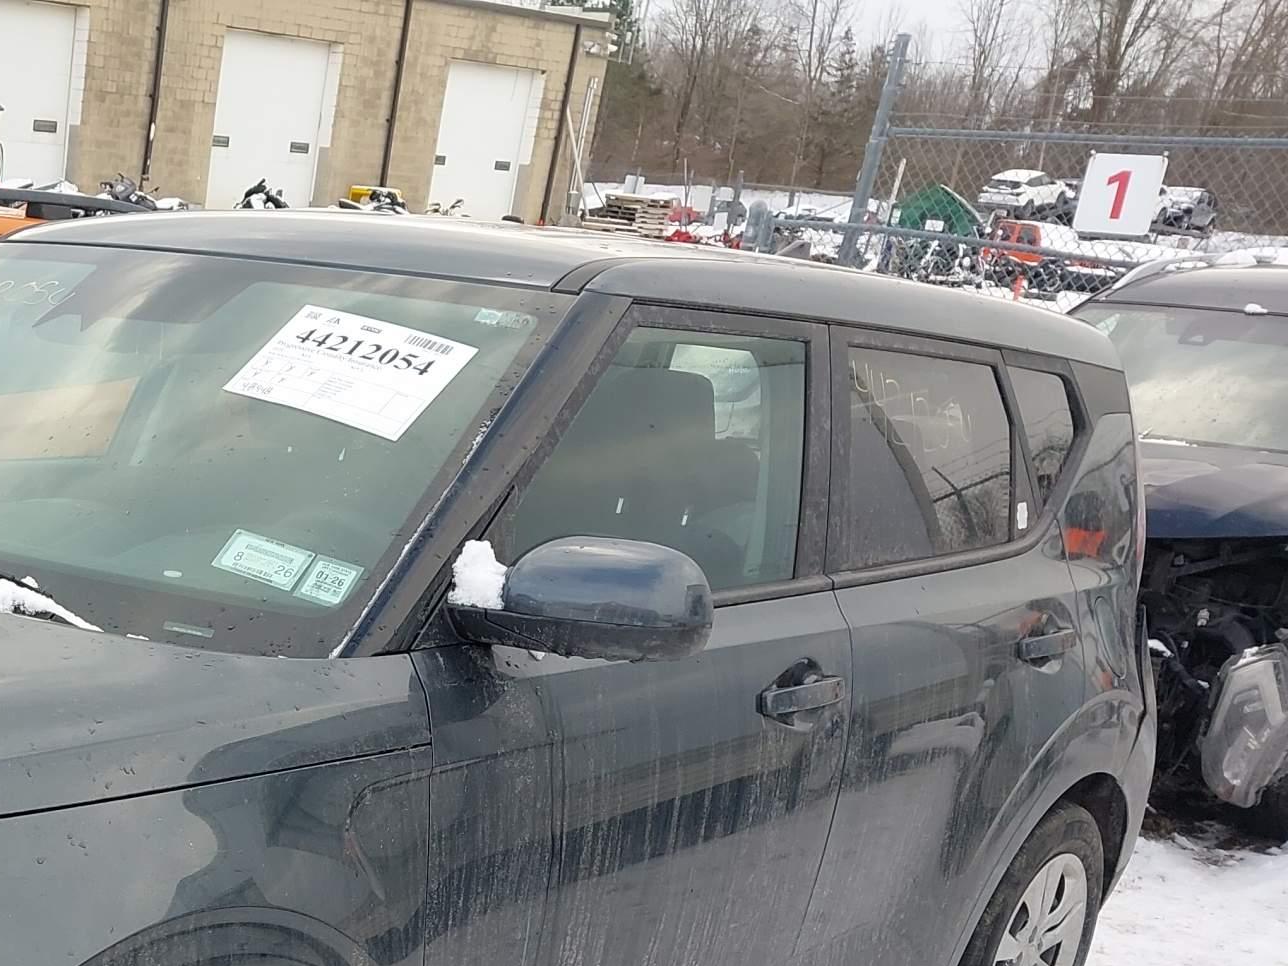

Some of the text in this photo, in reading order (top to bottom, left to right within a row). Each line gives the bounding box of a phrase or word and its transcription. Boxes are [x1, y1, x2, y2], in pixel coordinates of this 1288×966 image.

[1105, 169, 1133, 220] 1
[295, 328, 436, 376] 44212054
[233, 551, 245, 562] 8
[274, 564, 295, 578] 26
[315, 570, 345, 587] 01-26
